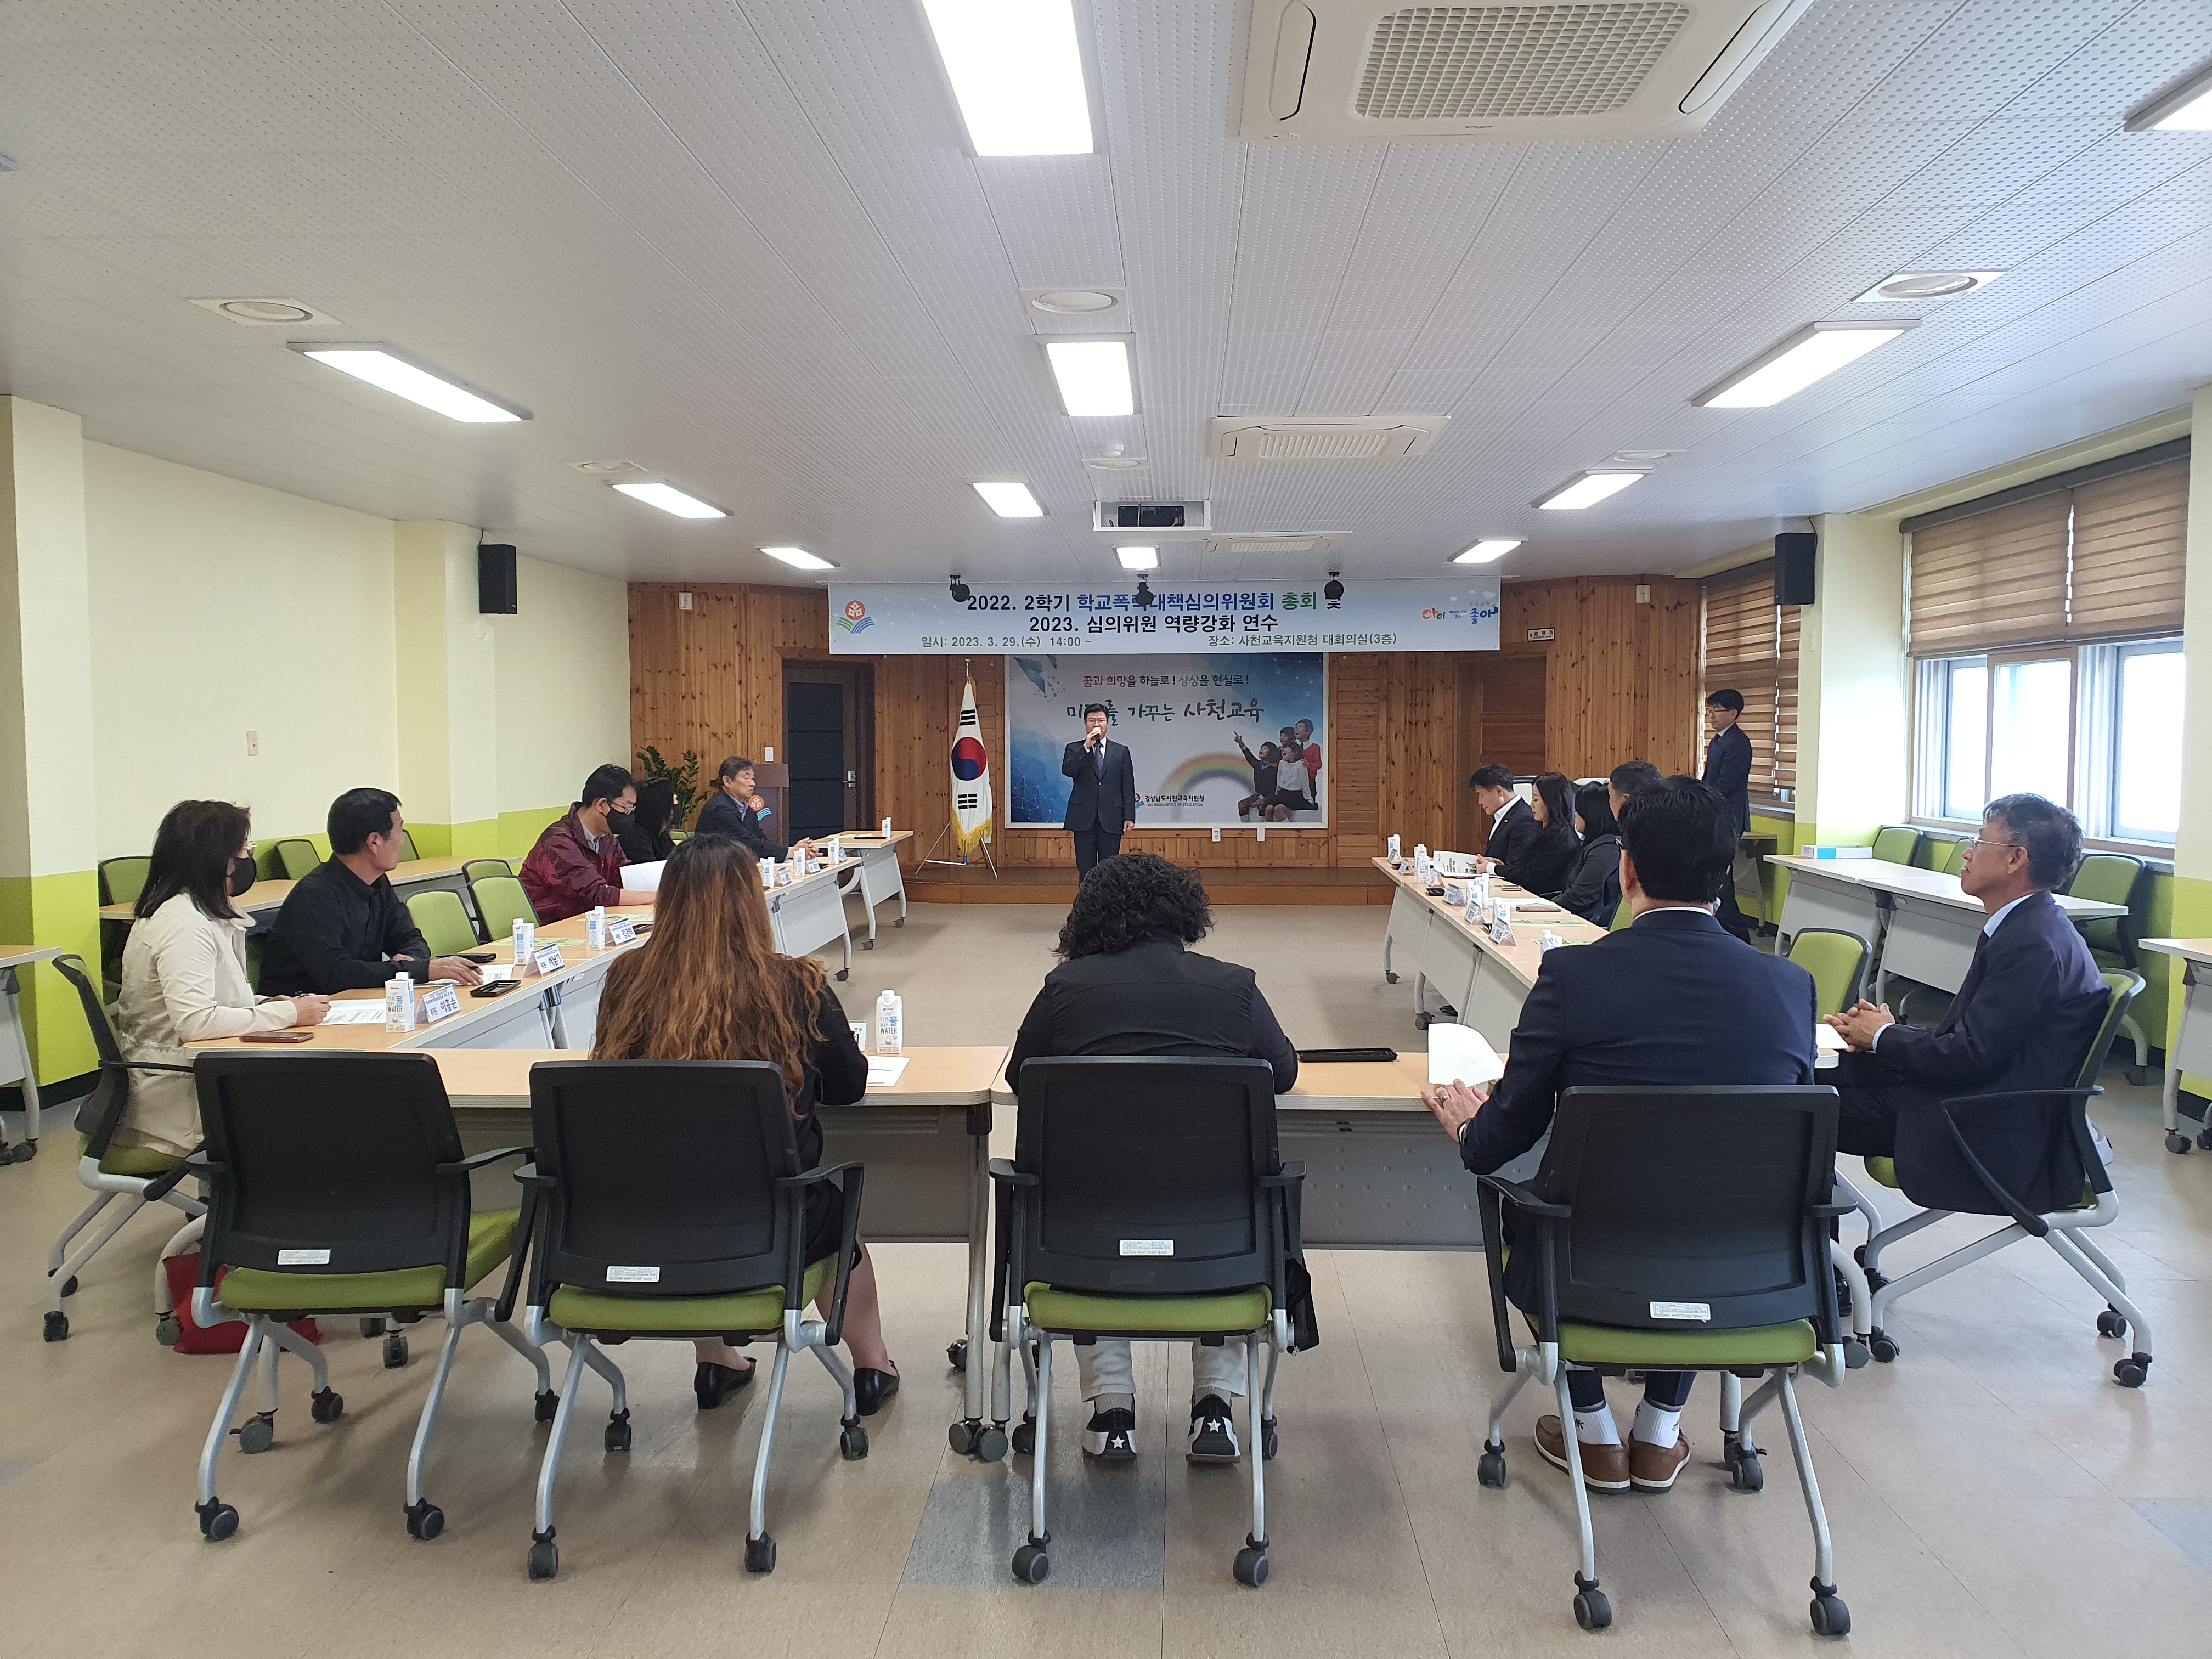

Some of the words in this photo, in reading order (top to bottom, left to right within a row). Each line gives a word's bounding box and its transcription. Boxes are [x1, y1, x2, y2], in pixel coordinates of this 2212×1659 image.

[967, 595, 1016, 610] 2022.
[1024, 594, 1069, 612] 2학기
[1281, 591, 1317, 610] 총회
[1029, 617, 1079, 631] 2023.
[1087, 615, 1156, 634] 심의위원
[1164, 614, 1235, 633] 역량강화
[1243, 613, 1278, 632] 연수
[922, 636, 947, 647] 일시:
[951, 637, 983, 646] 2023.
[987, 637, 997, 646] 3.
[1049, 636, 1081, 646] 14:00
[1208, 635, 1234, 647] 장소:
[1238, 634, 1318, 646] 사천교육지원청
[1323, 633, 1397, 646] 대회의실(3층)
[1082, 675, 1103, 687] 꿈과
[1106, 675, 1137, 687] 희망을
[1178, 674, 1209, 687] 상상을
[1066, 699, 1119, 726] 미를
[1128, 703, 1175, 722] 가꾸는
[1184, 698, 1264, 723] 사천교육
[889, 1016, 898, 1027] 물
